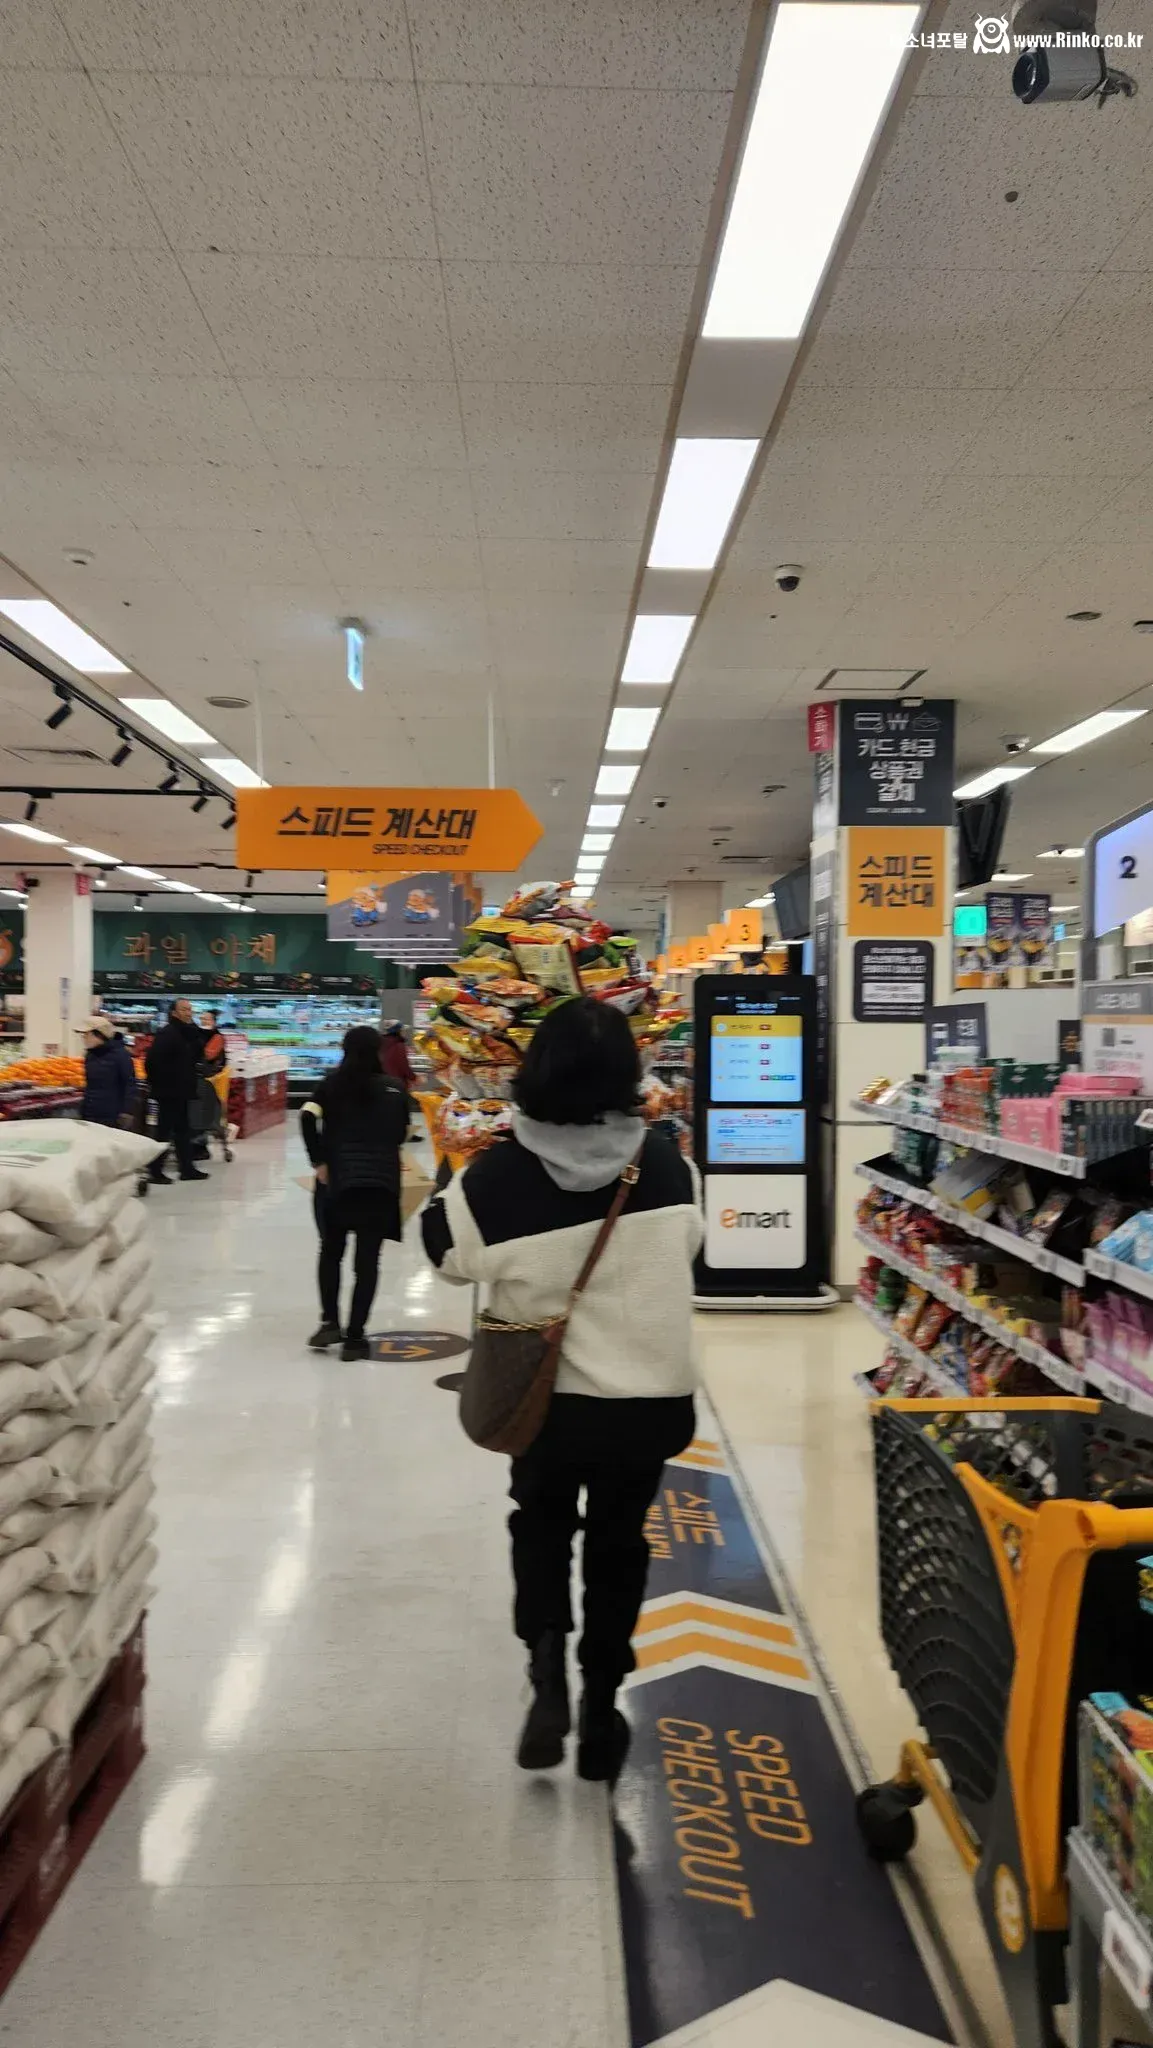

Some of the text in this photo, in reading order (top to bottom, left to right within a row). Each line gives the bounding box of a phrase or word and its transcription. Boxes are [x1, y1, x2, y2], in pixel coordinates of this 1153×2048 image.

[858, 738, 936, 757] 카드 현금
[868, 760, 925, 779] 상품권
[878, 782, 916, 802] 결제
[277, 807, 478, 839] 스피드 계산대
[372, 843, 469, 856] SPEED CHECKOUT
[859, 855, 935, 879] 스피드
[1119, 855, 1138, 880] 2
[859, 882, 936, 908] 계산대
[741, 923, 751, 941] 3
[122, 931, 277, 966] 과일 야채
[719, 1208, 793, 1230] emart
[664, 1489, 726, 1546] 스피드
[724, 1729, 812, 1845] SPEED
[656, 1717, 756, 1921] CHECKOUT
